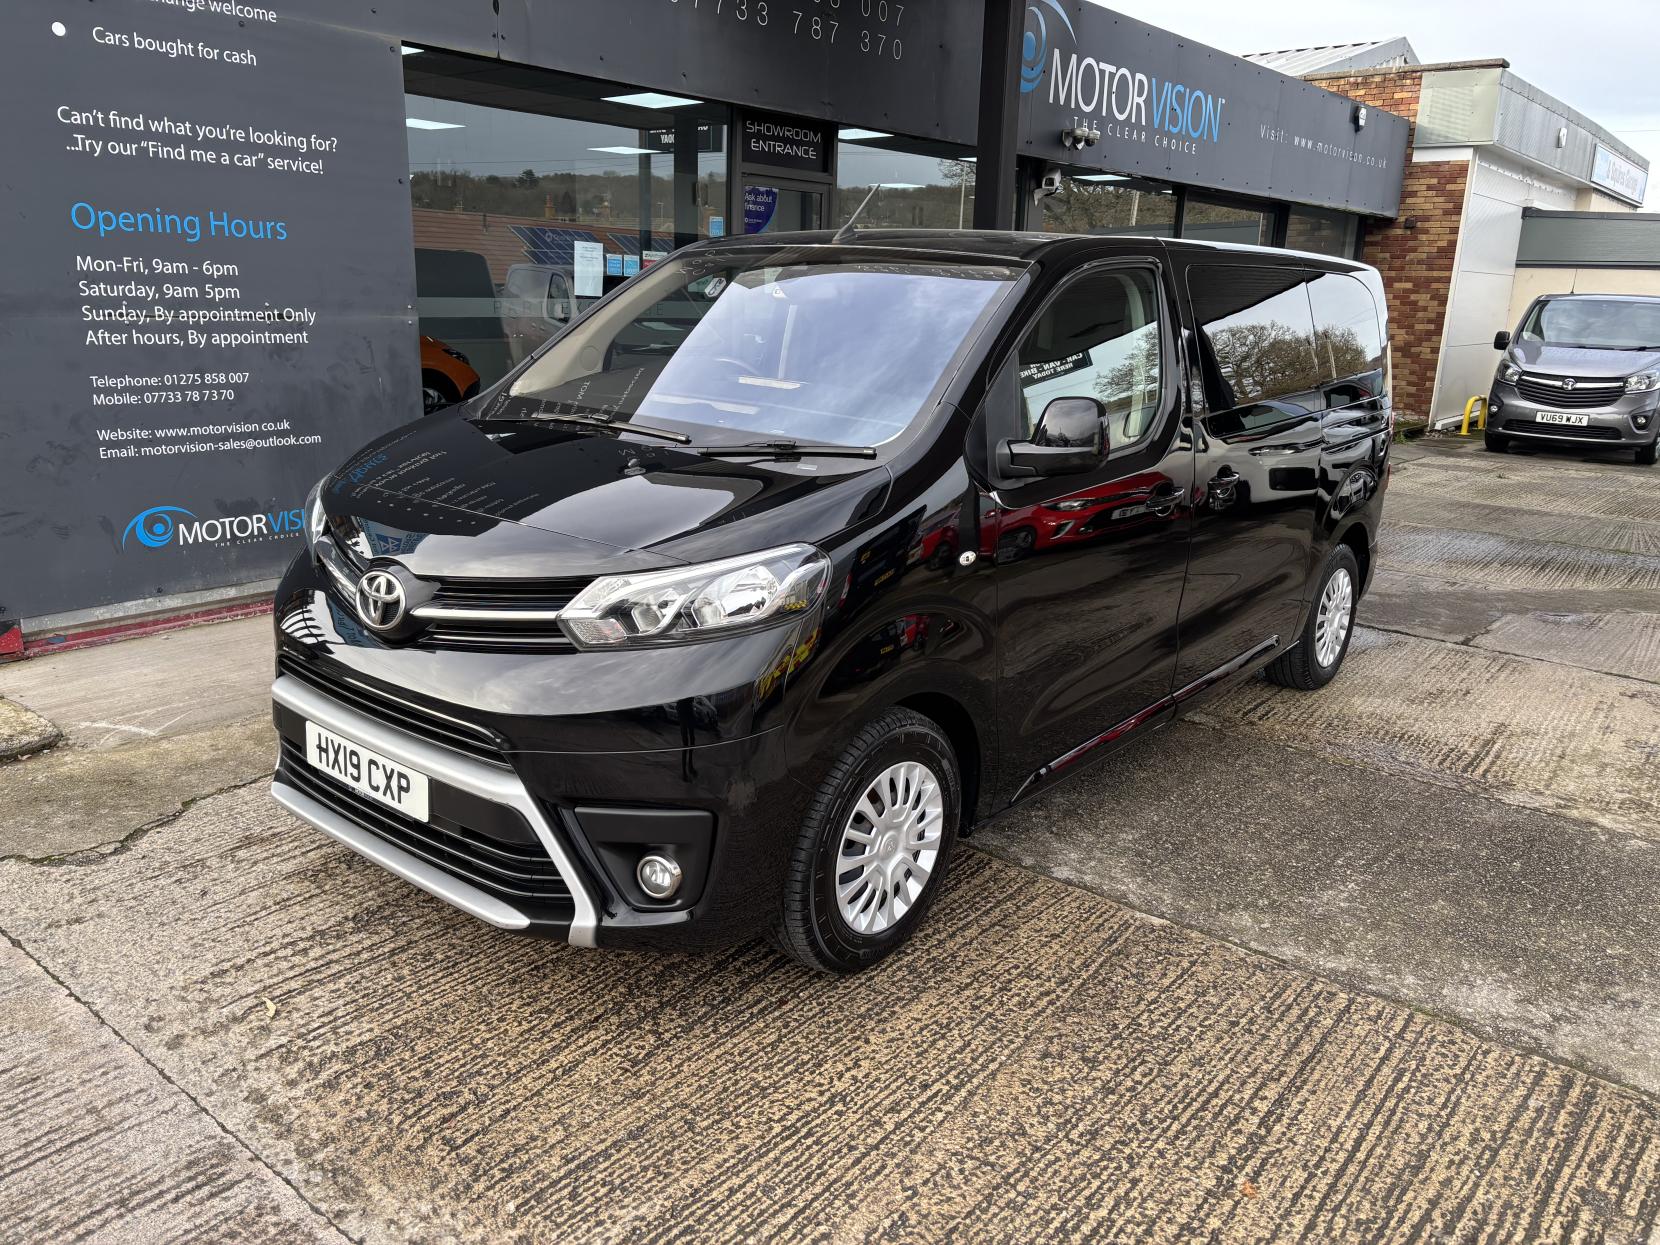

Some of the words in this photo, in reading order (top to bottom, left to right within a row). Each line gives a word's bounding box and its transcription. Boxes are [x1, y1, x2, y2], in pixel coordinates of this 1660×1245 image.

[208, 0, 278, 23] welcome
[861, 0, 905, 27] 007
[92, 26, 130, 47] Cars
[133, 31, 195, 58] bought
[197, 42, 220, 61] for
[223, 49, 257, 67] cash
[792, 10, 840, 44] 787
[860, 30, 903, 60] 370
[1048, 47, 1223, 143] MOTORVISION
[108, 110, 145, 131] find
[148, 116, 193, 136] what
[248, 126, 307, 153] looking
[309, 134, 338, 153] for?
[746, 121, 821, 143] SHOWROOM
[1107, 123, 1146, 143] CLEAR
[1154, 135, 1196, 155] CHOICE
[1260, 123, 1288, 144] Visit:
[107, 141, 139, 156] our
[189, 149, 217, 164] me
[220, 152, 230, 165] a
[267, 156, 324, 175] service!
[751, 139, 817, 158] ENTRANCE
[71, 202, 201, 243] Opening
[210, 212, 288, 241] Hours
[76, 255, 149, 275] Mon-Fri,
[152, 258, 189, 275] 9am
[202, 260, 239, 279] 6pm
[78, 280, 159, 302] Saturday,
[162, 283, 199, 299] 9am
[205, 283, 241, 302] 5pm
[81, 305, 150, 323] Sunday,
[154, 307, 173, 324] By
[179, 308, 280, 324] appointment
[283, 308, 316, 325] Only
[85, 328, 129, 346] After
[132, 329, 184, 347] hours,
[187, 329, 208, 349] By
[211, 330, 309, 348] appointment
[89, 374, 162, 390] Telephone:
[163, 373, 202, 386] 01275
[204, 372, 227, 384] 858
[228, 372, 250, 384] 007
[92, 392, 141, 406] Mobile:
[143, 391, 182, 404] 07733
[96, 427, 153, 441] Website:
[154, 421, 260, 438] www.motorvision
[261, 418, 291, 432] co.uk
[1541, 414, 1563, 422] VU69
[1565, 416, 1583, 424] WJX
[99, 444, 139, 459] Email:
[140, 433, 322, 456] motorvision-sales@outlook.com
[178, 508, 306, 546] MOTORVISI
[316, 732, 361, 783] HX19
[367, 758, 411, 804] CXP
